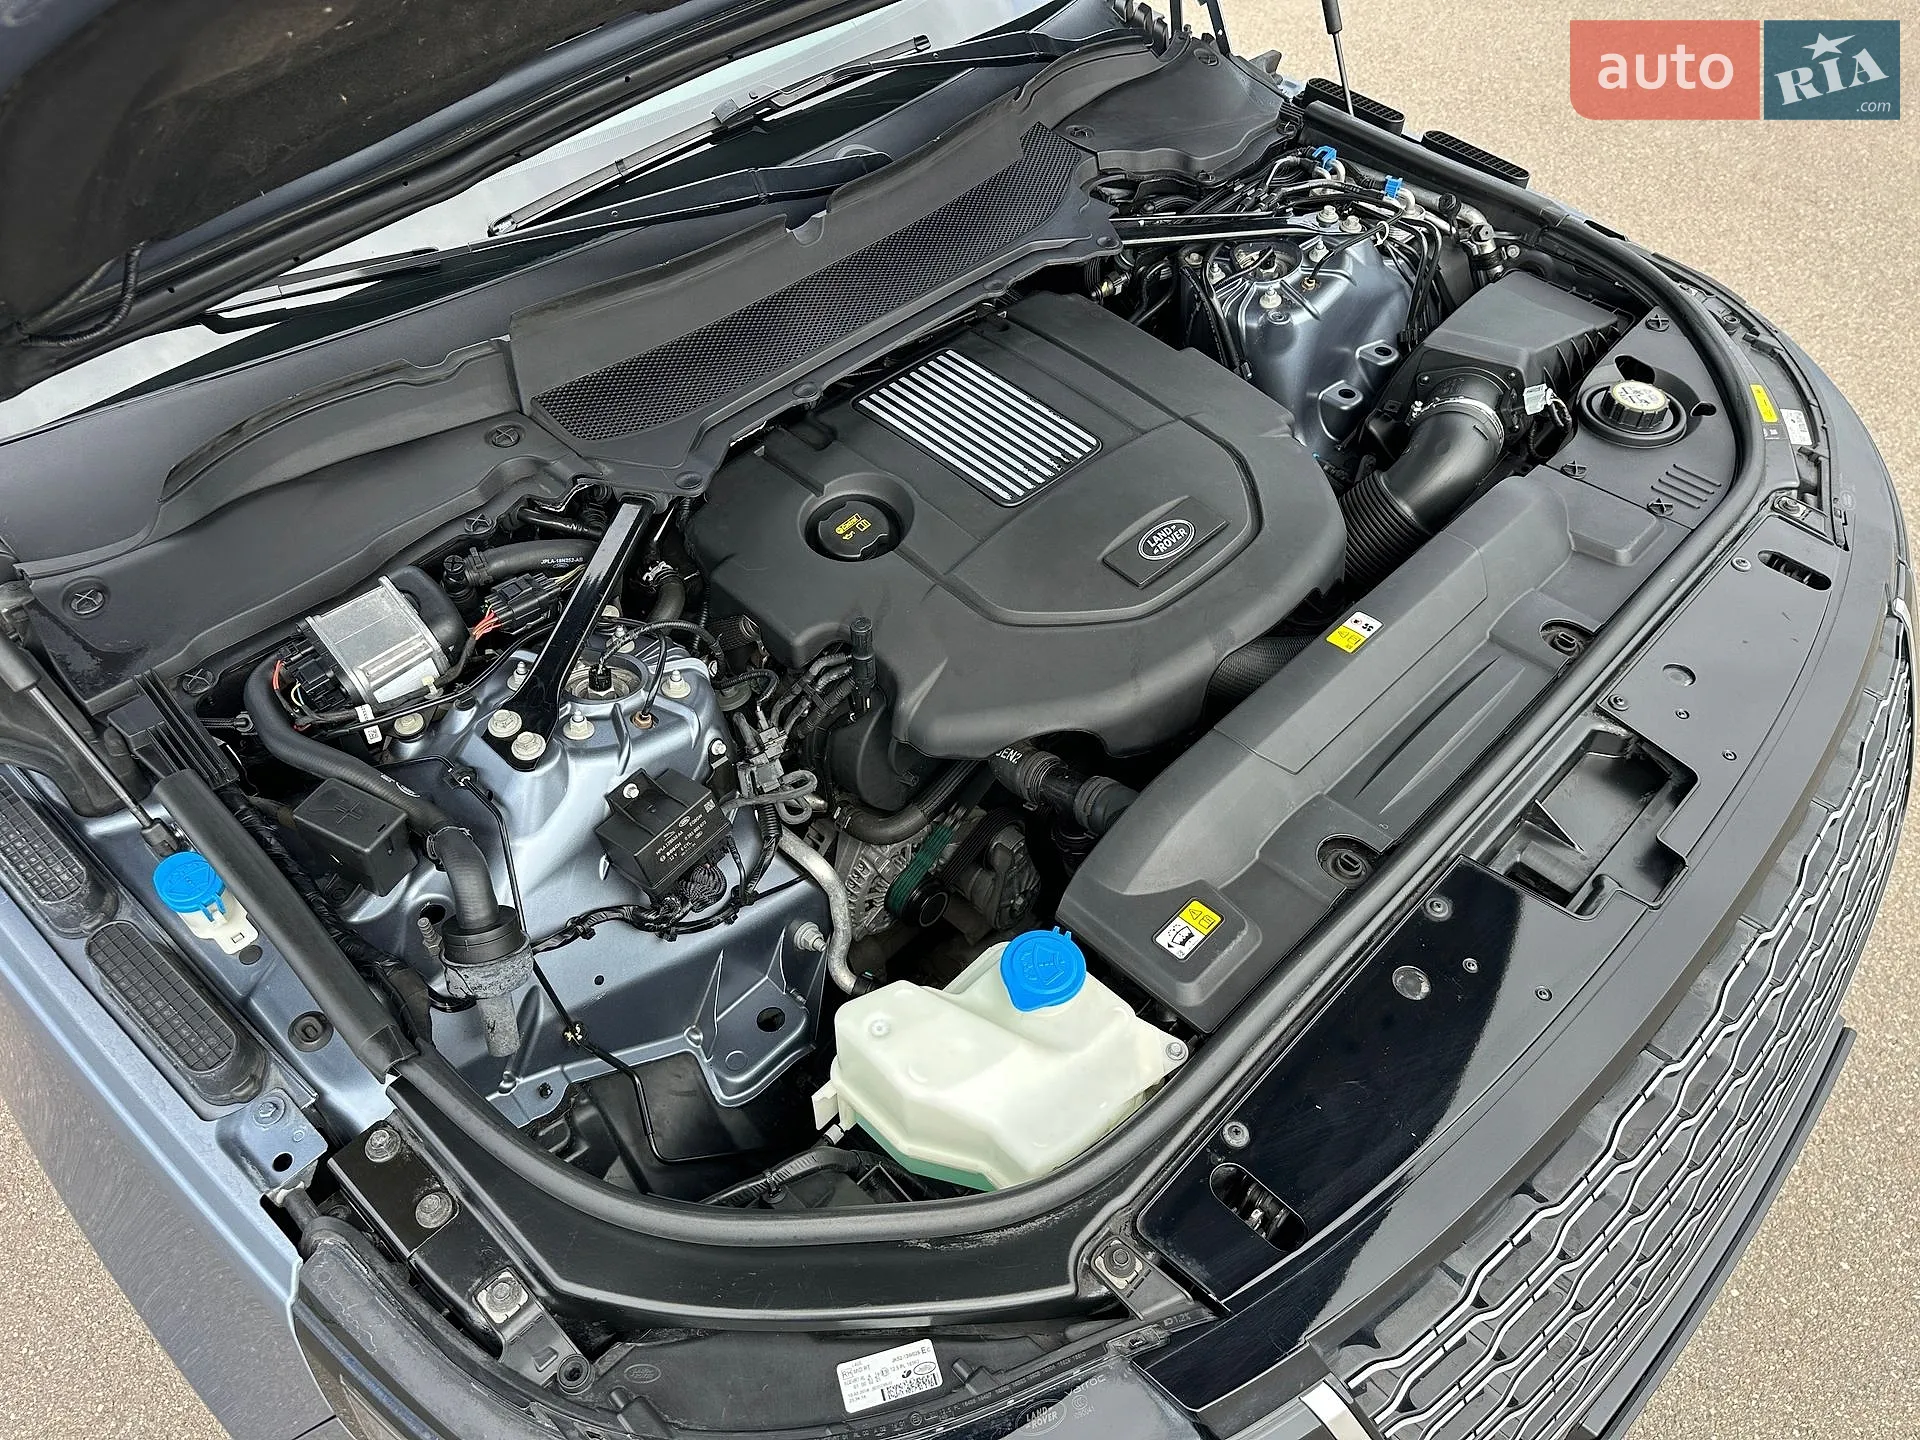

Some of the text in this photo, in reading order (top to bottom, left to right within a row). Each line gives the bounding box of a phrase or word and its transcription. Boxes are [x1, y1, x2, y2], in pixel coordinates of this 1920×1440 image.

[1146, 527, 1173, 548] LAND
[1157, 527, 1188, 552] ROVER
[1026, 1406, 1048, 1422] LAND
[1031, 1411, 1058, 1429] ROVER
